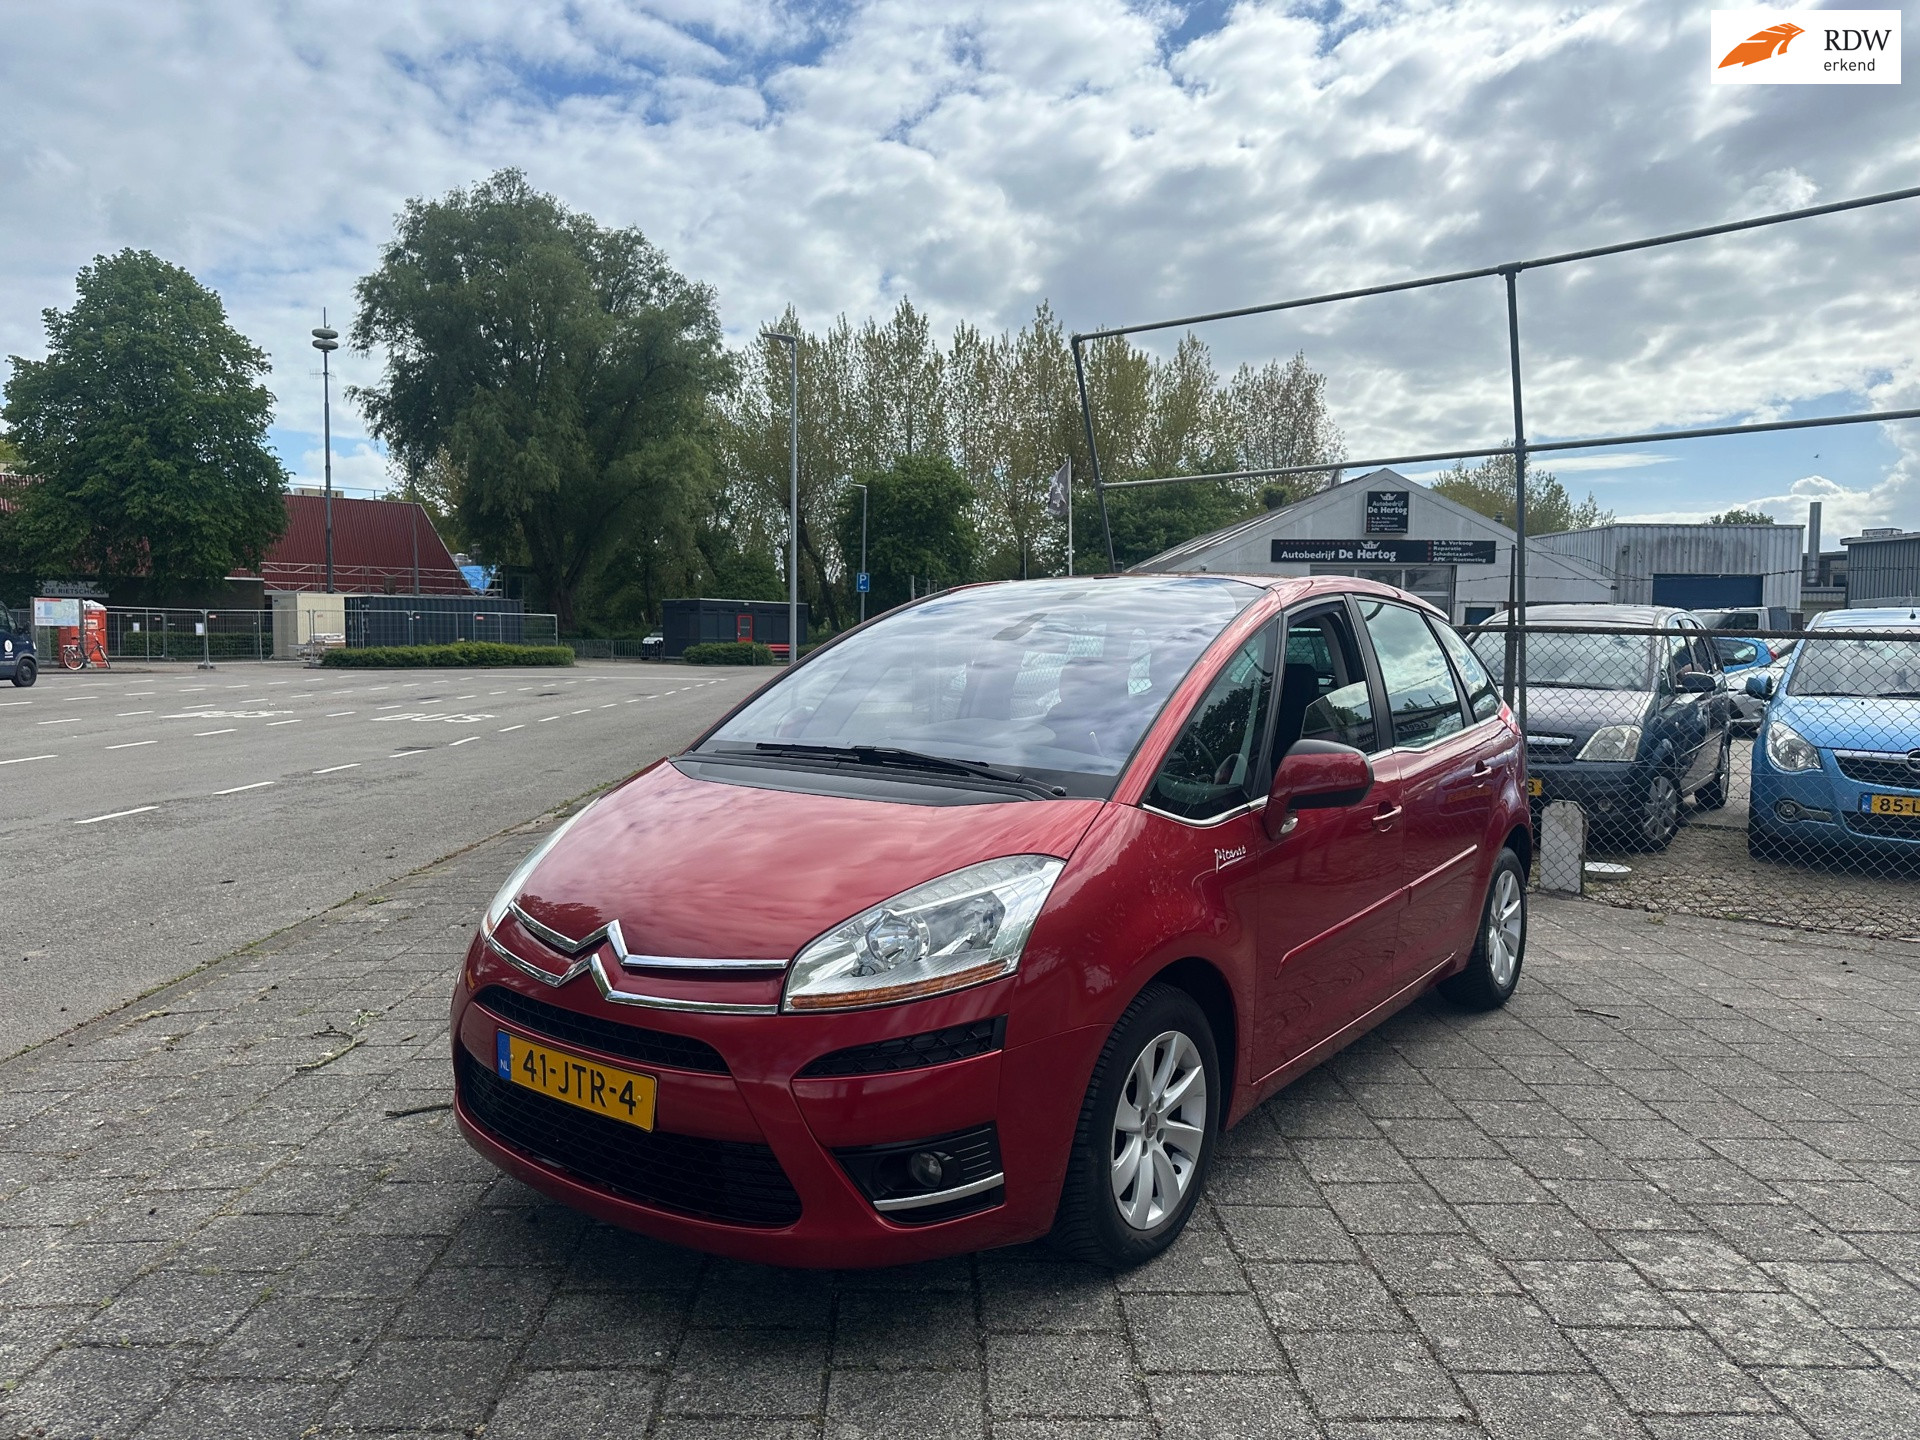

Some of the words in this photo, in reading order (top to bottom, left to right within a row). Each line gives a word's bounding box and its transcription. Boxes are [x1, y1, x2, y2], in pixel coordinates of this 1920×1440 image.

[1381, 507, 1407, 515] Hertog
[1281, 551, 1335, 560] Autobedrijf
[1339, 550, 1353, 559] De
[1357, 550, 1397, 562] Hertog
[860, 575, 867, 584] P
[371, 712, 495, 723] BUS
[500, 1058, 510, 1072] NL
[523, 1050, 637, 1115] 41-JTR-4
